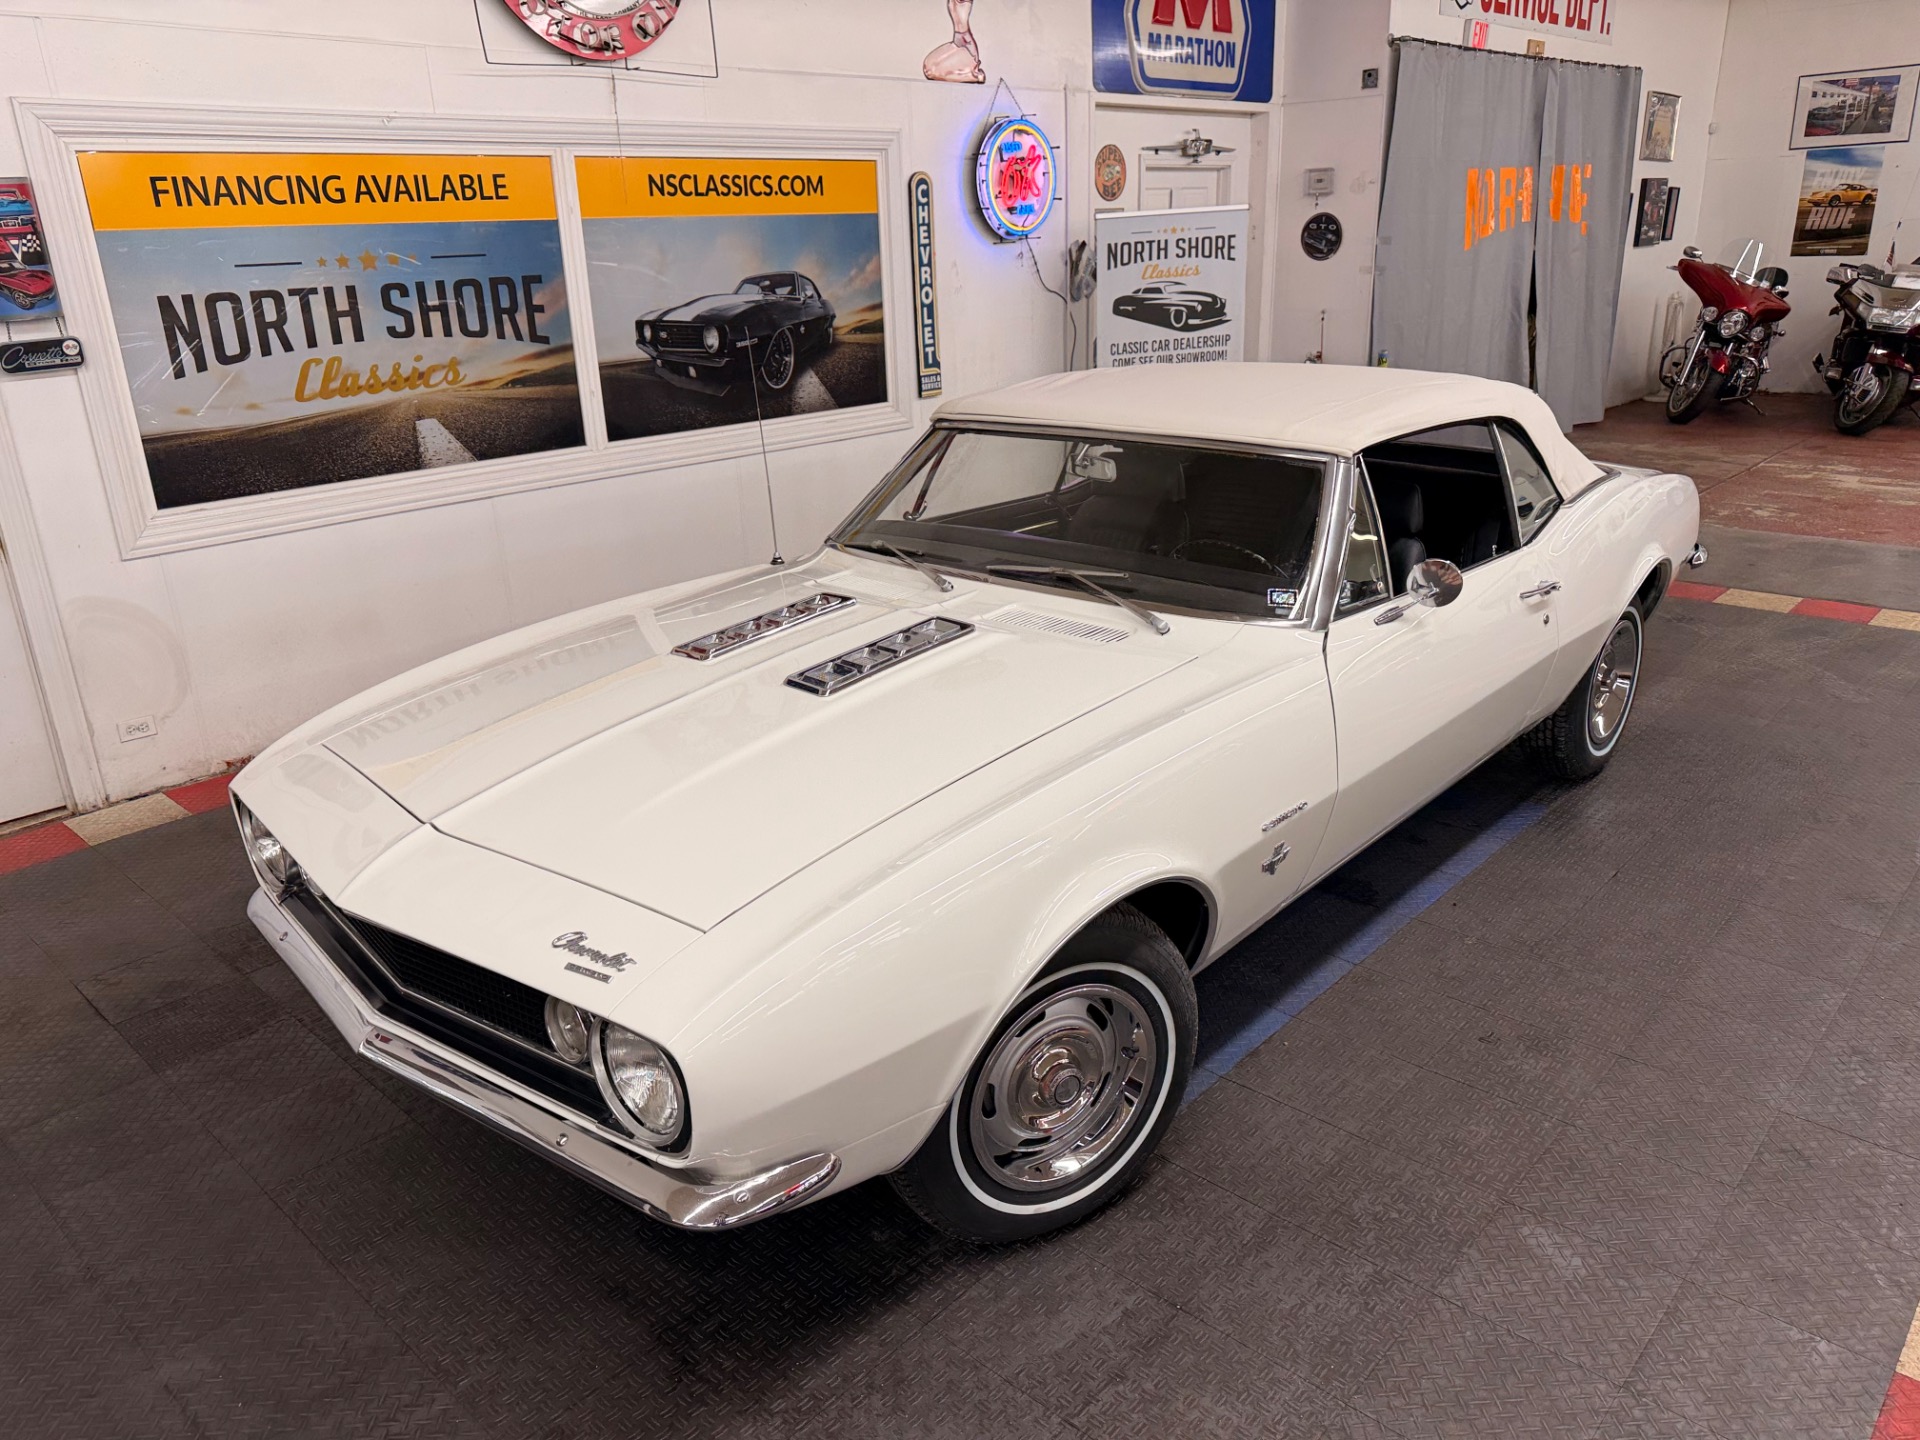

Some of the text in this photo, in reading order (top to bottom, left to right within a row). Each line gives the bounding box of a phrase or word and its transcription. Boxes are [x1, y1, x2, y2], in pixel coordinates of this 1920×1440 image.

[1472, 21, 1489, 49] EXIT
[1148, 32, 1236, 68] MARATHON
[149, 173, 509, 207] FINANCING AVAILABLE
[647, 173, 824, 197] NSCLASSICS.COM
[1102, 177, 1122, 198] BEE
[1309, 223, 1337, 231] GTO
[1805, 206, 1856, 230] RIDE
[1107, 234, 1236, 271] NORTH SHORE
[917, 184, 934, 365] CHEVROLET
[1141, 263, 1201, 280] Classics
[157, 274, 551, 380] NORTH SHORE
[1110, 334, 1231, 356] CLASSIC CAR DEALERSHIP
[1156, 353, 1174, 363] OUR
[1175, 350, 1228, 363] SHOWROOM!
[2, 346, 65, 369] Corvette
[294, 354, 466, 403] Classics
[921, 376, 936, 384] SALES
